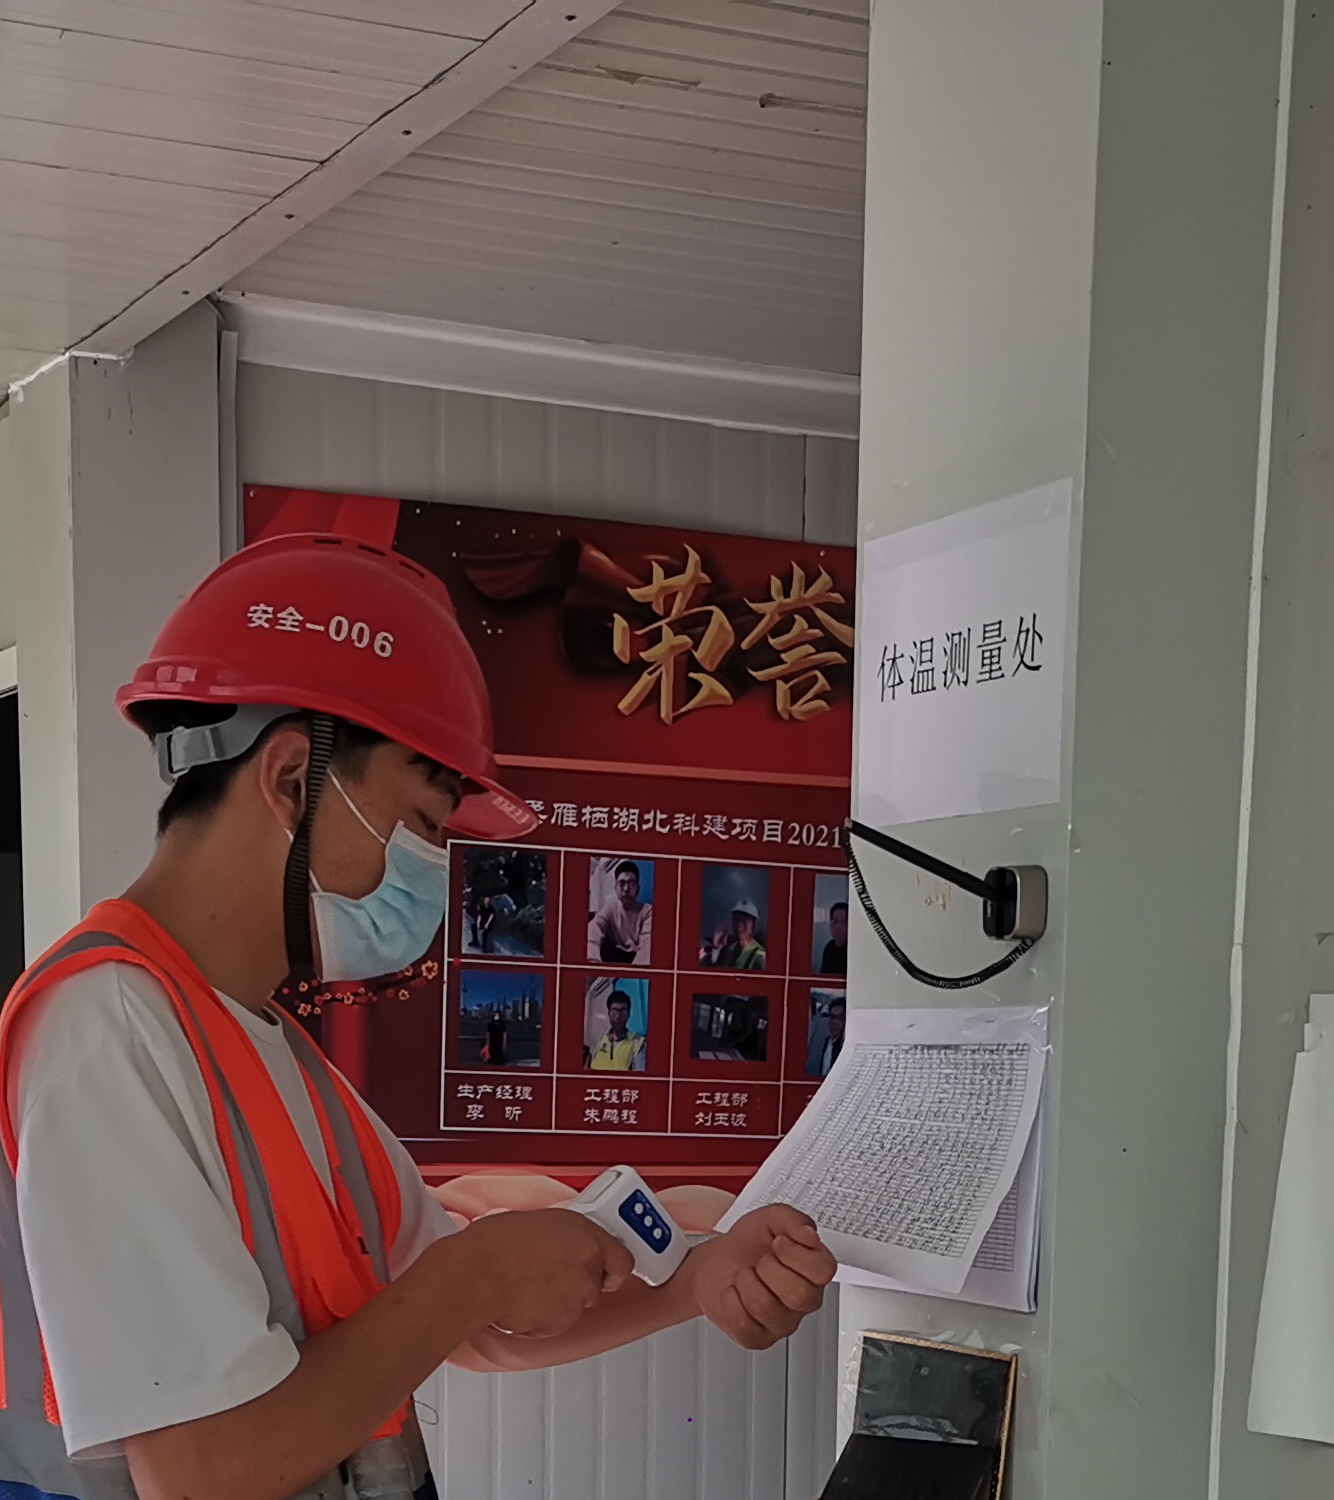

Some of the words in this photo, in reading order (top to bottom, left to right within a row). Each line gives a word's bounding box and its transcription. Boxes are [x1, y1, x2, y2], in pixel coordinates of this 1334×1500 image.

[613, 544, 854, 725] 荣誉
[876, 613, 1043, 702] 体温测量处
[456, 1084, 533, 1102] 生产经理
[585, 1088, 639, 1104] 工程部
[695, 1091, 749, 1107] 工程部
